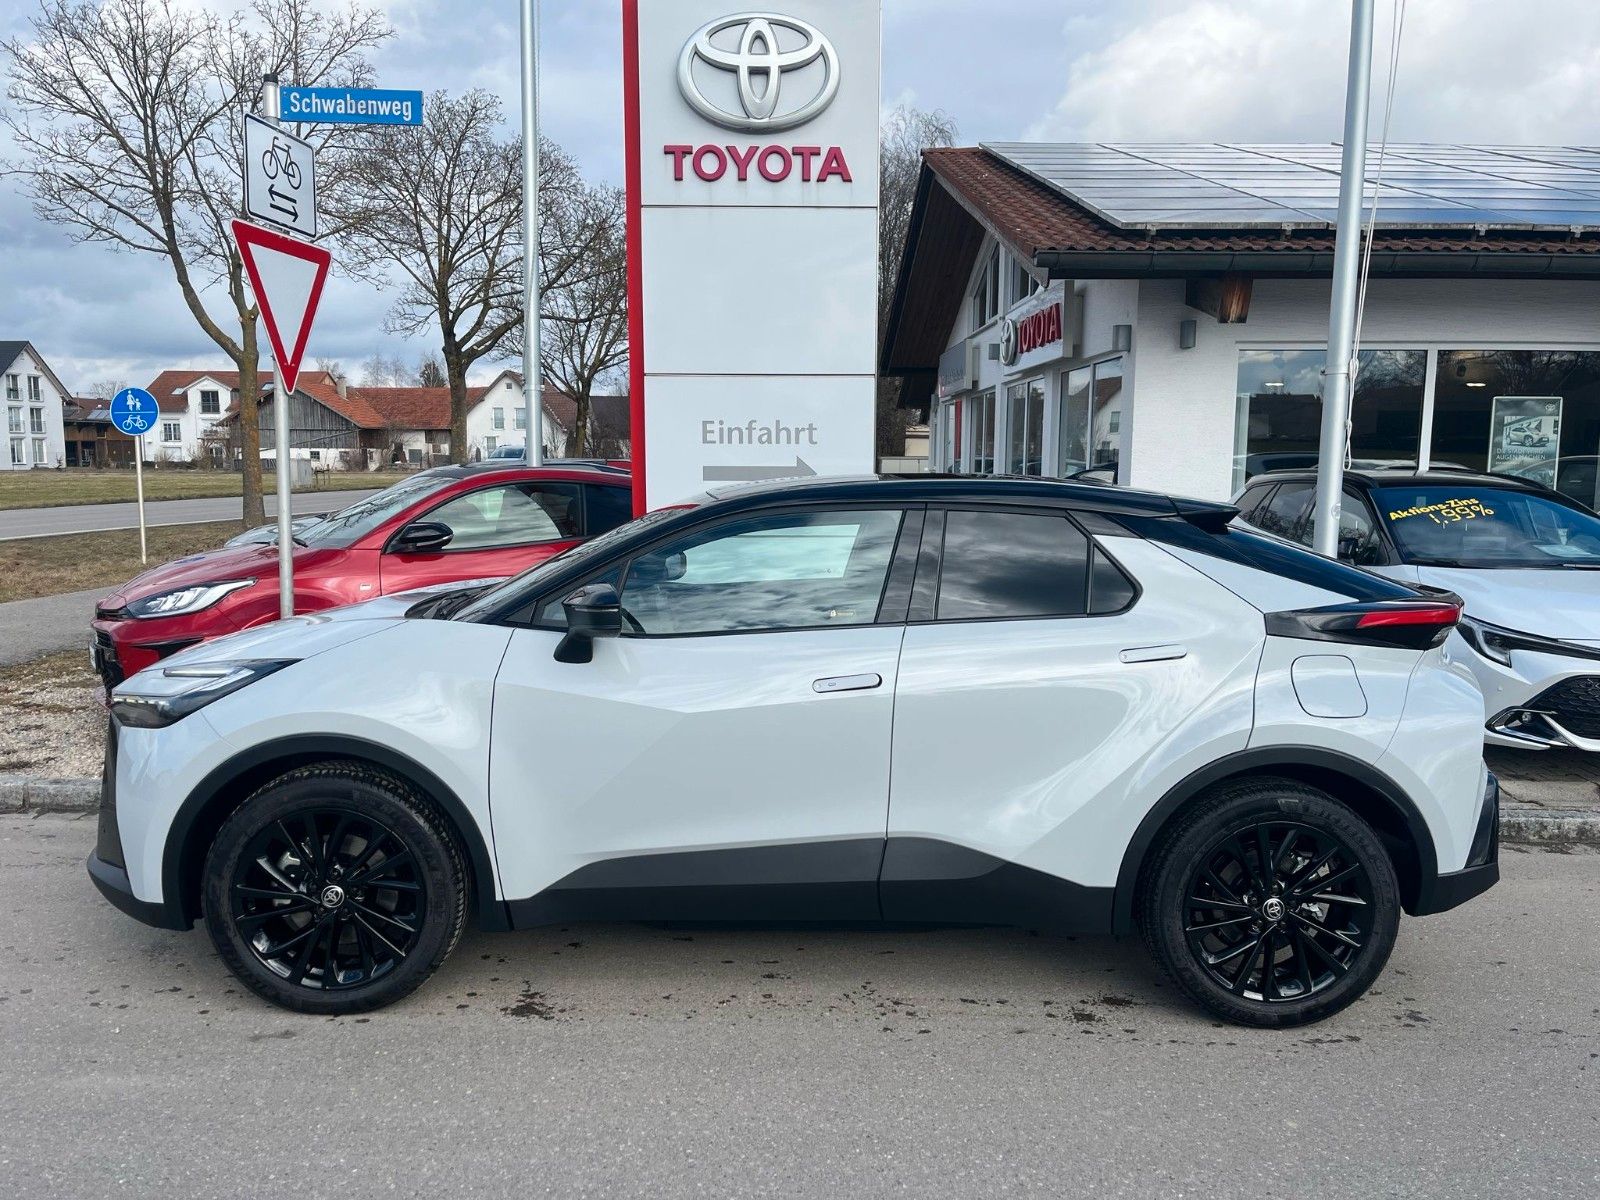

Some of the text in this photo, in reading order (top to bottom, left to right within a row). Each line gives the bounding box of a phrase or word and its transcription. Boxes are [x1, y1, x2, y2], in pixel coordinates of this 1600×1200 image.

[290, 91, 412, 121] Schwabenweg
[663, 144, 852, 182] TOYOTA
[1017, 303, 1062, 354] TOYOTA
[701, 419, 818, 445] Einfahrt
[1389, 498, 1479, 520] Aktions-Zins
